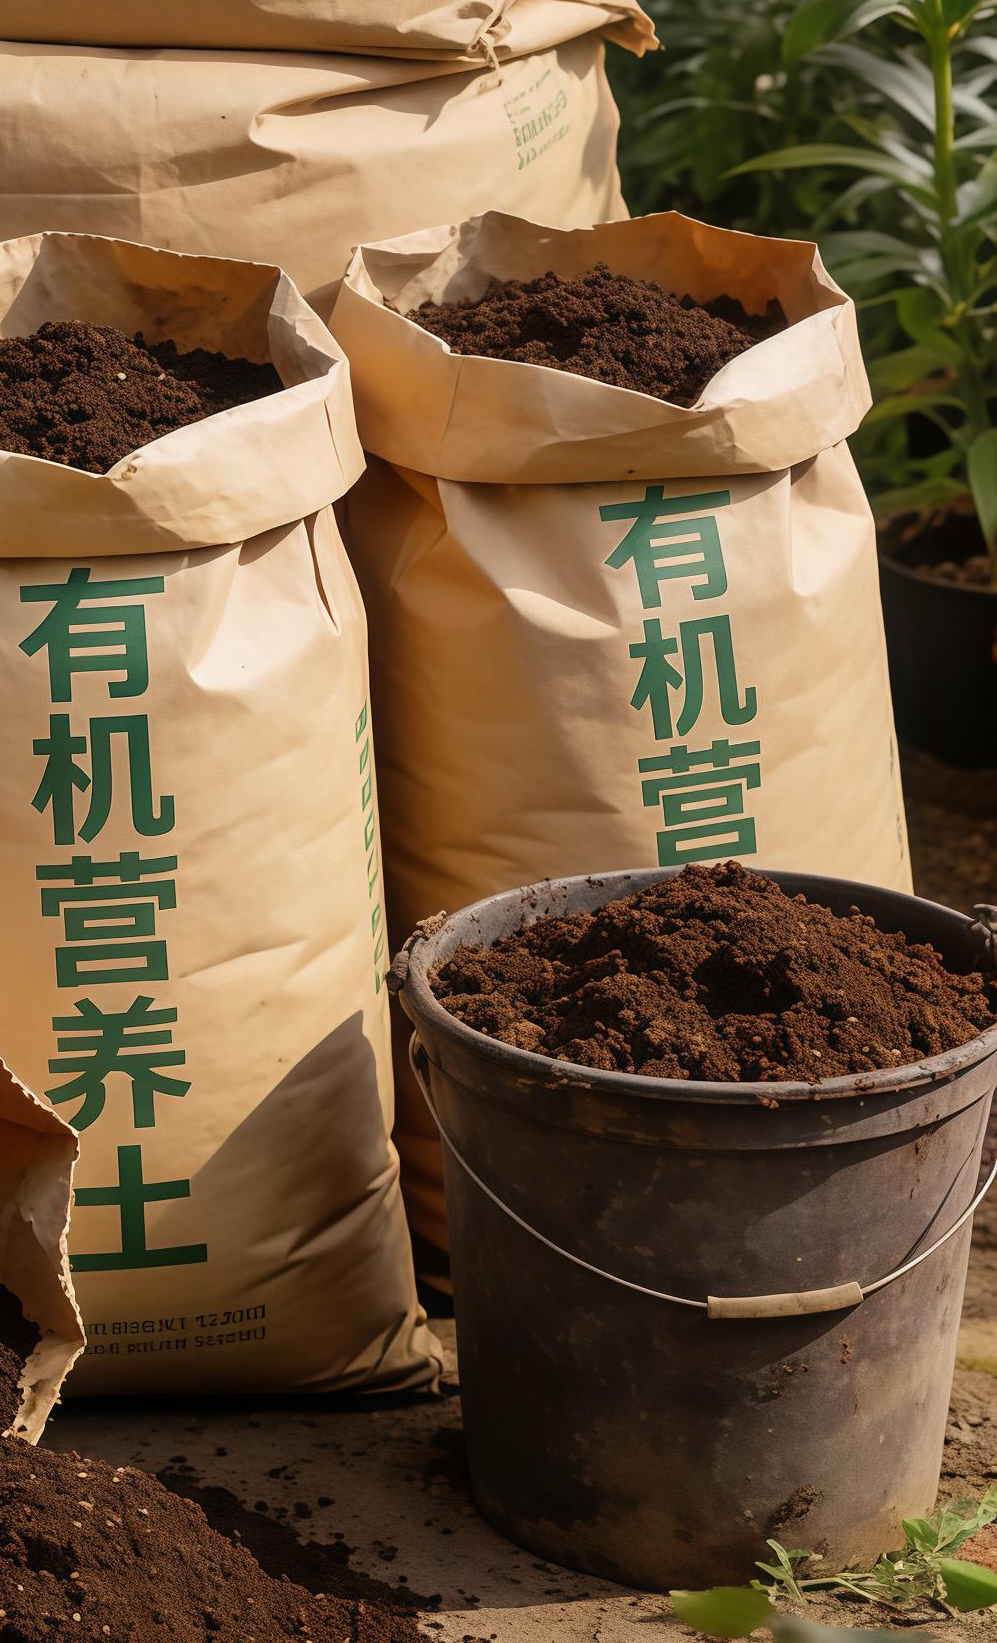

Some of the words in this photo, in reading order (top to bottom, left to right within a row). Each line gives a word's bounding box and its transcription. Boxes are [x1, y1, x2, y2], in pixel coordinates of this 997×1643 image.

[18, 567, 208, 1273] 有机营养土
[599, 485, 761, 867] 有机营
